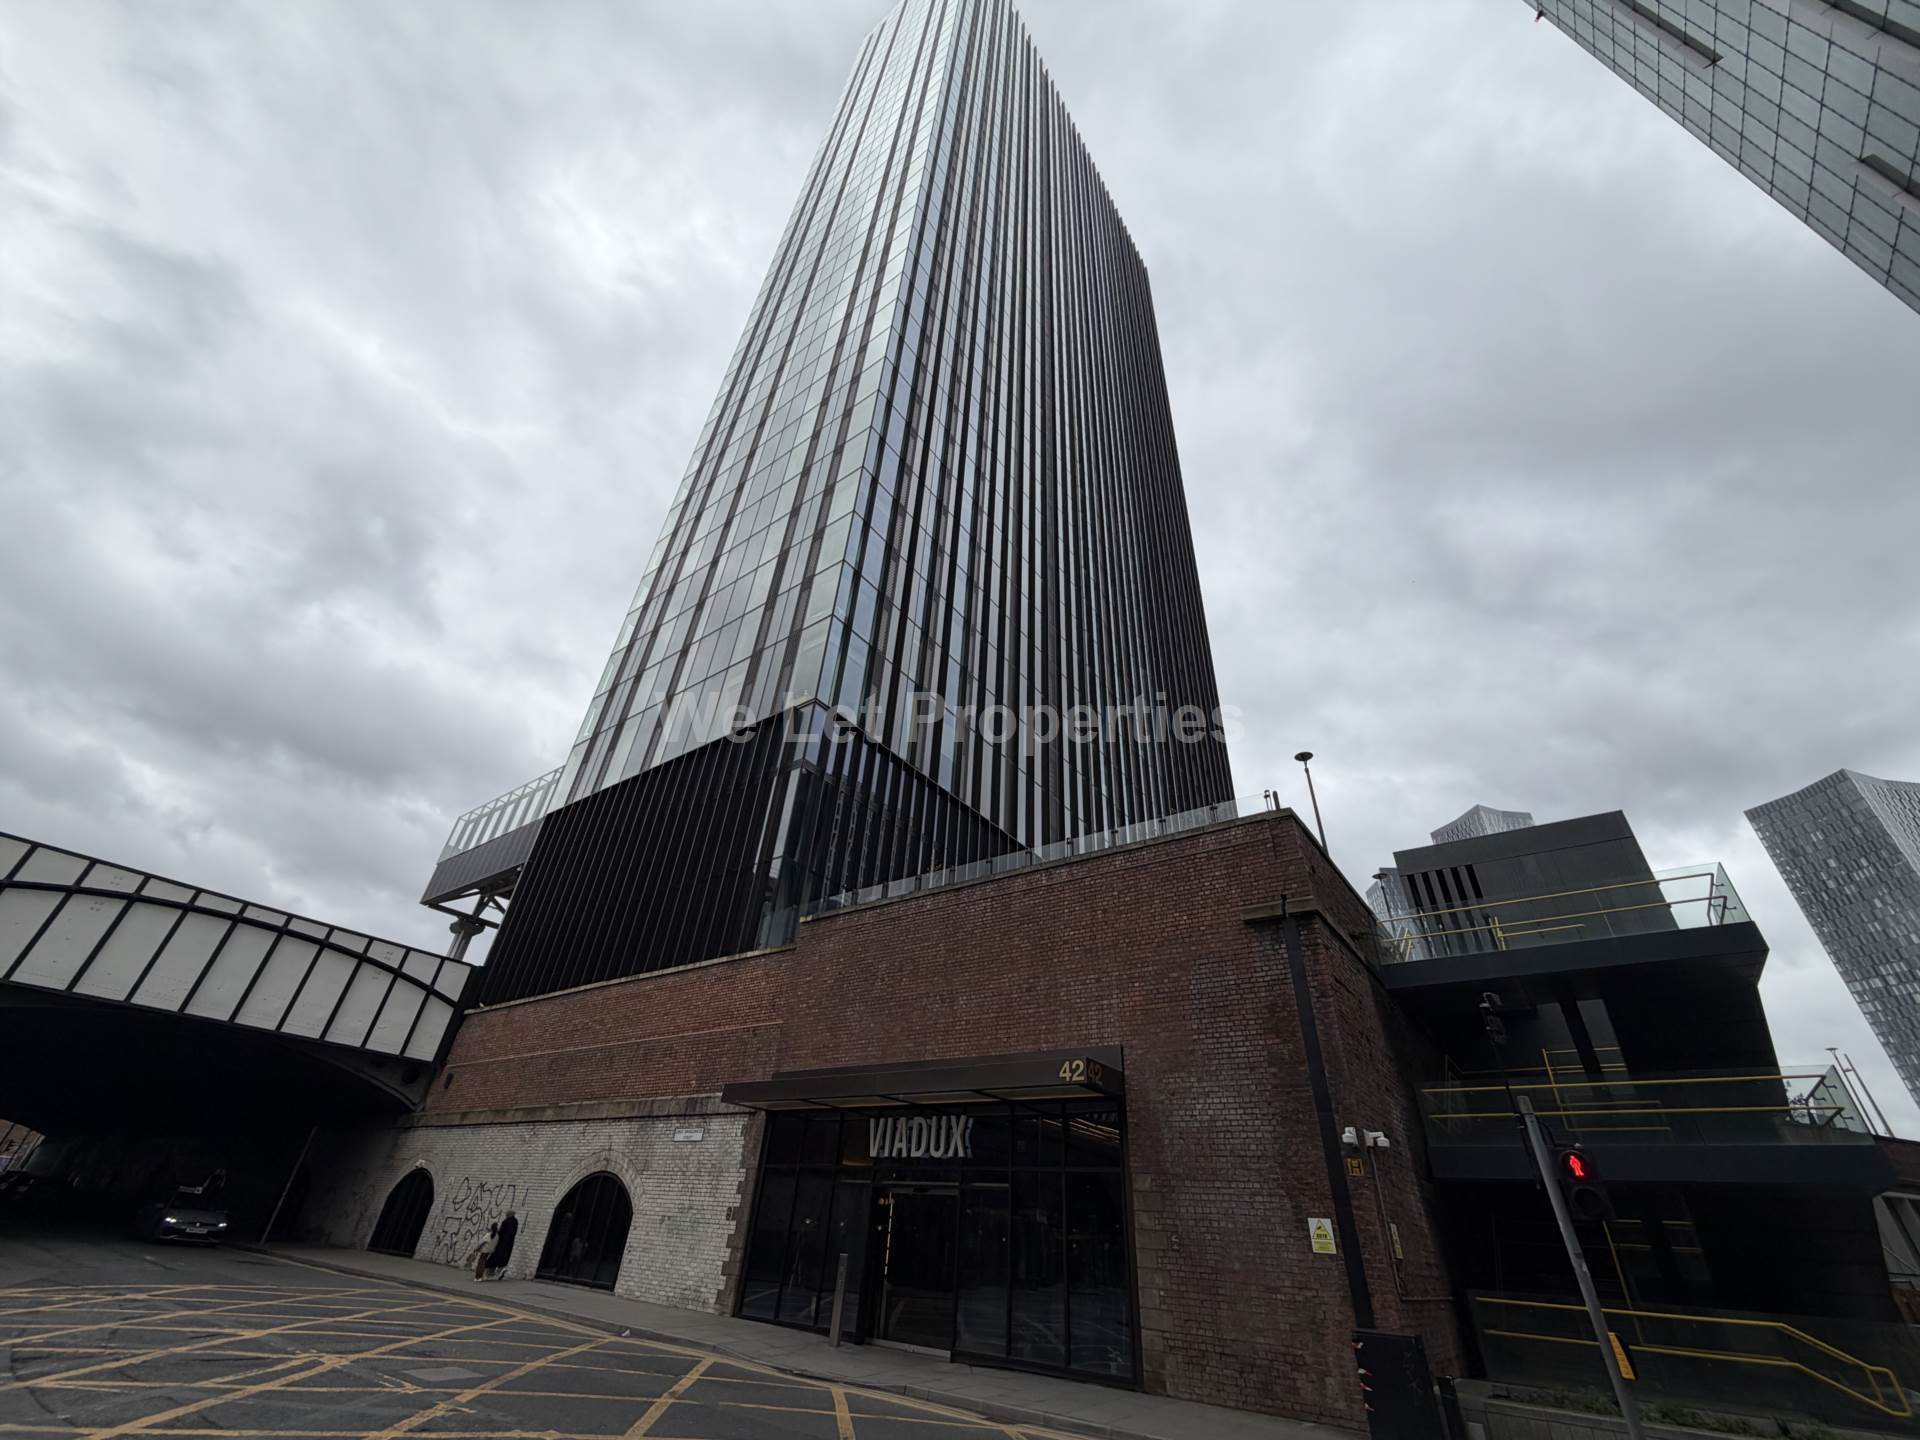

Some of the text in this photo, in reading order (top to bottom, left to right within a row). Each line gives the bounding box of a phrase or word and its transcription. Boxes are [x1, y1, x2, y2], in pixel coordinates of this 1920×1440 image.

[1059, 1060, 1084, 1081] 42
[1088, 1062, 1103, 1086] 42
[868, 1114, 967, 1159] VIADUX
